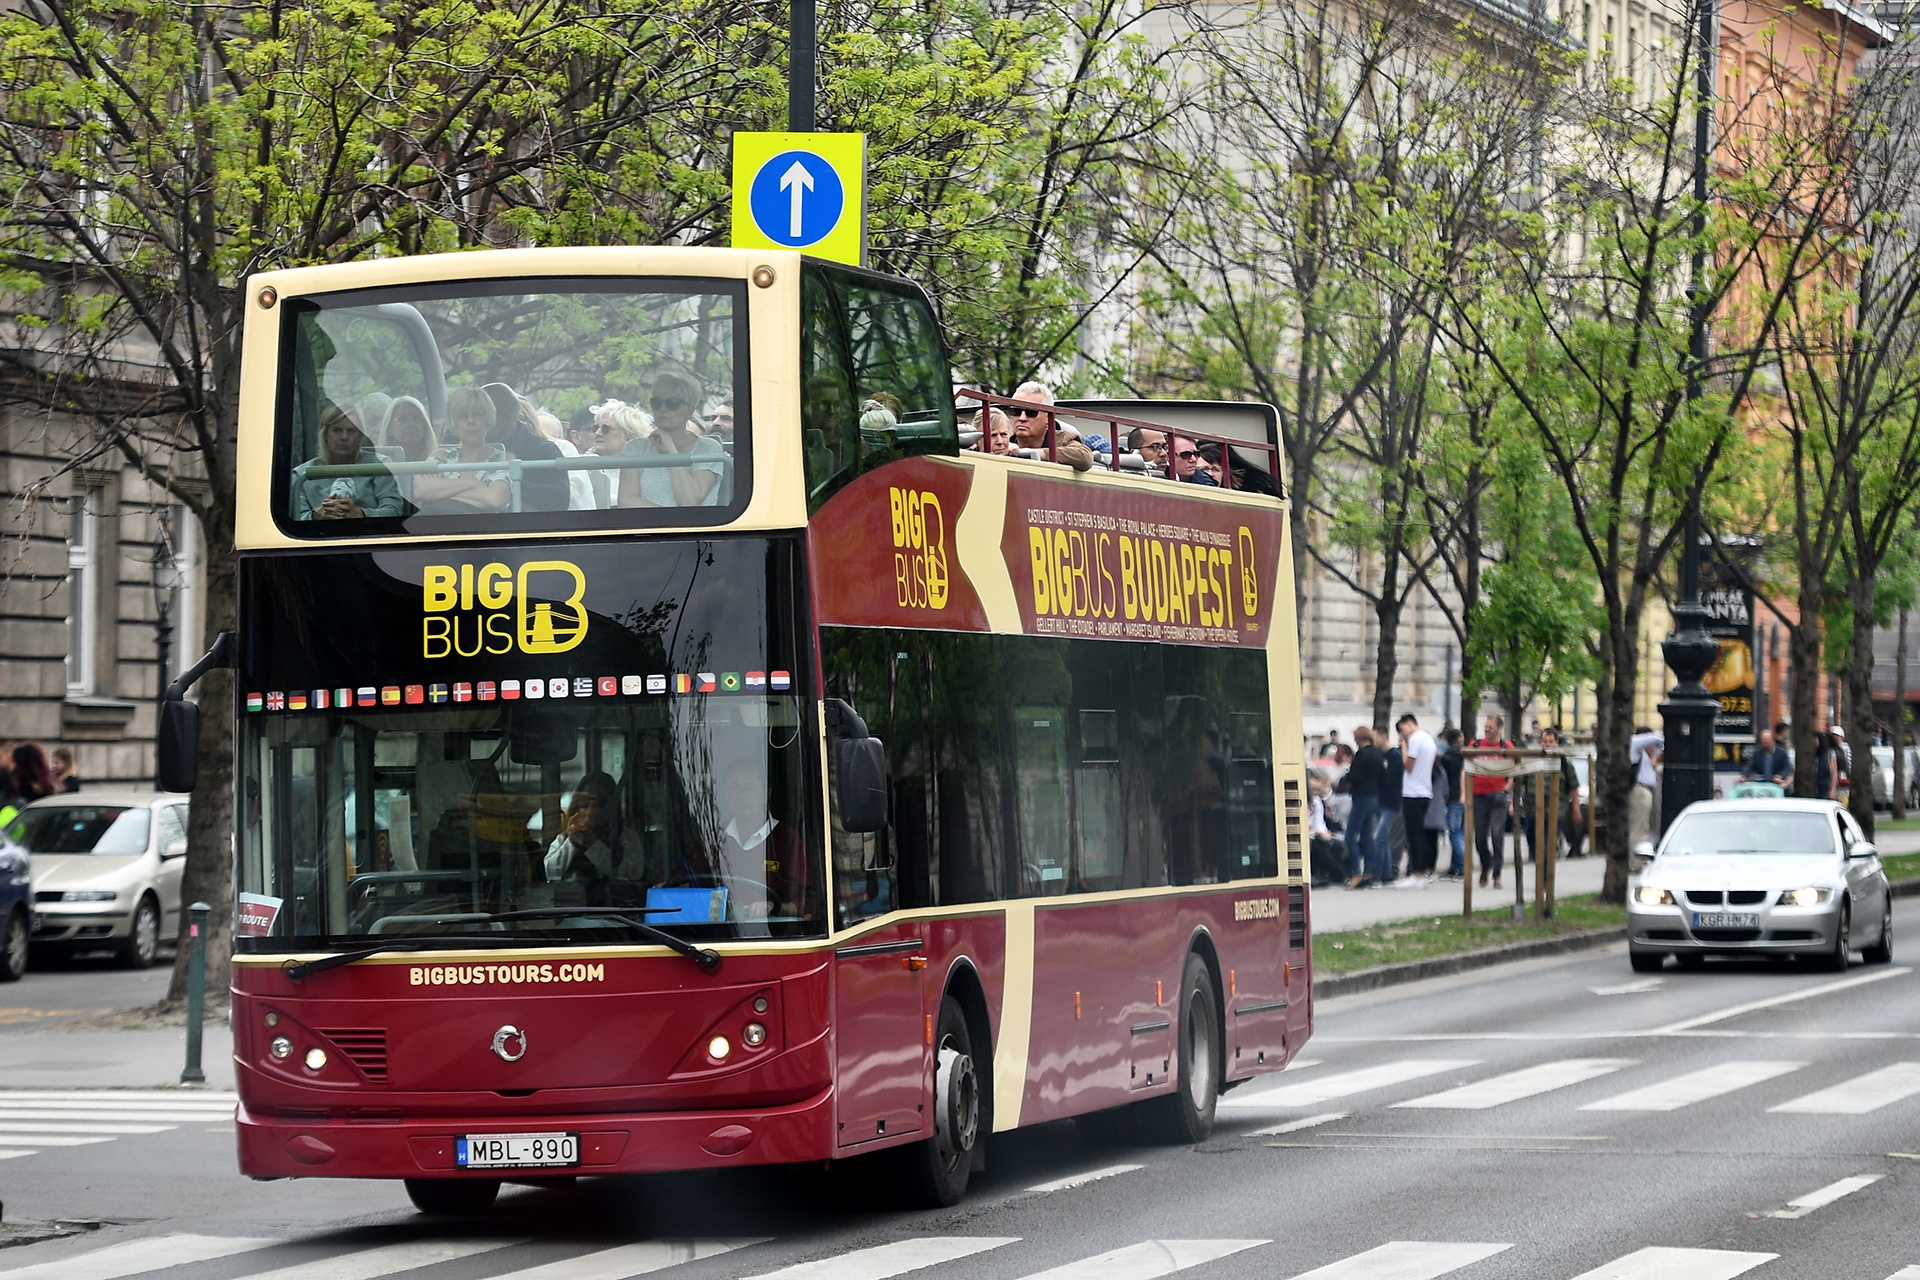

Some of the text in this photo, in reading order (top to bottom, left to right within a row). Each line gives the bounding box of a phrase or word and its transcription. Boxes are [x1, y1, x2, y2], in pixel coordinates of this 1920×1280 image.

[890, 487, 922, 550] BIG
[1027, 508, 1045, 524] CASTLE
[1045, 509, 1064, 525] DISTRICT
[1097, 514, 1117, 531] BASILICA
[1118, 517, 1127, 533] THE
[1127, 519, 1141, 535] ROYAL
[1140, 521, 1156, 537] PALACE
[1173, 525, 1190, 541] SQUARE
[423, 562, 513, 613] BIG
[894, 553, 928, 609] BUS
[1119, 535, 1233, 629] BUDAPEST
[423, 613, 513, 659] BUS
[1055, 618, 1067, 633] HILL
[1068, 619, 1077, 634] THE
[1077, 620, 1096, 636] CITADEL
[1097, 621, 1123, 637] PARLIAMENT
[1125, 622, 1147, 638] MARGARET
[1146, 623, 1162, 639] ISLAND
[242, 914, 269, 927] ROUTE
[1234, 898, 1280, 922] BIGBUSTOURS.COM
[409, 963, 605, 986] BIGBUSTOURS.COM
[472, 1138, 573, 1161] MBL-890
